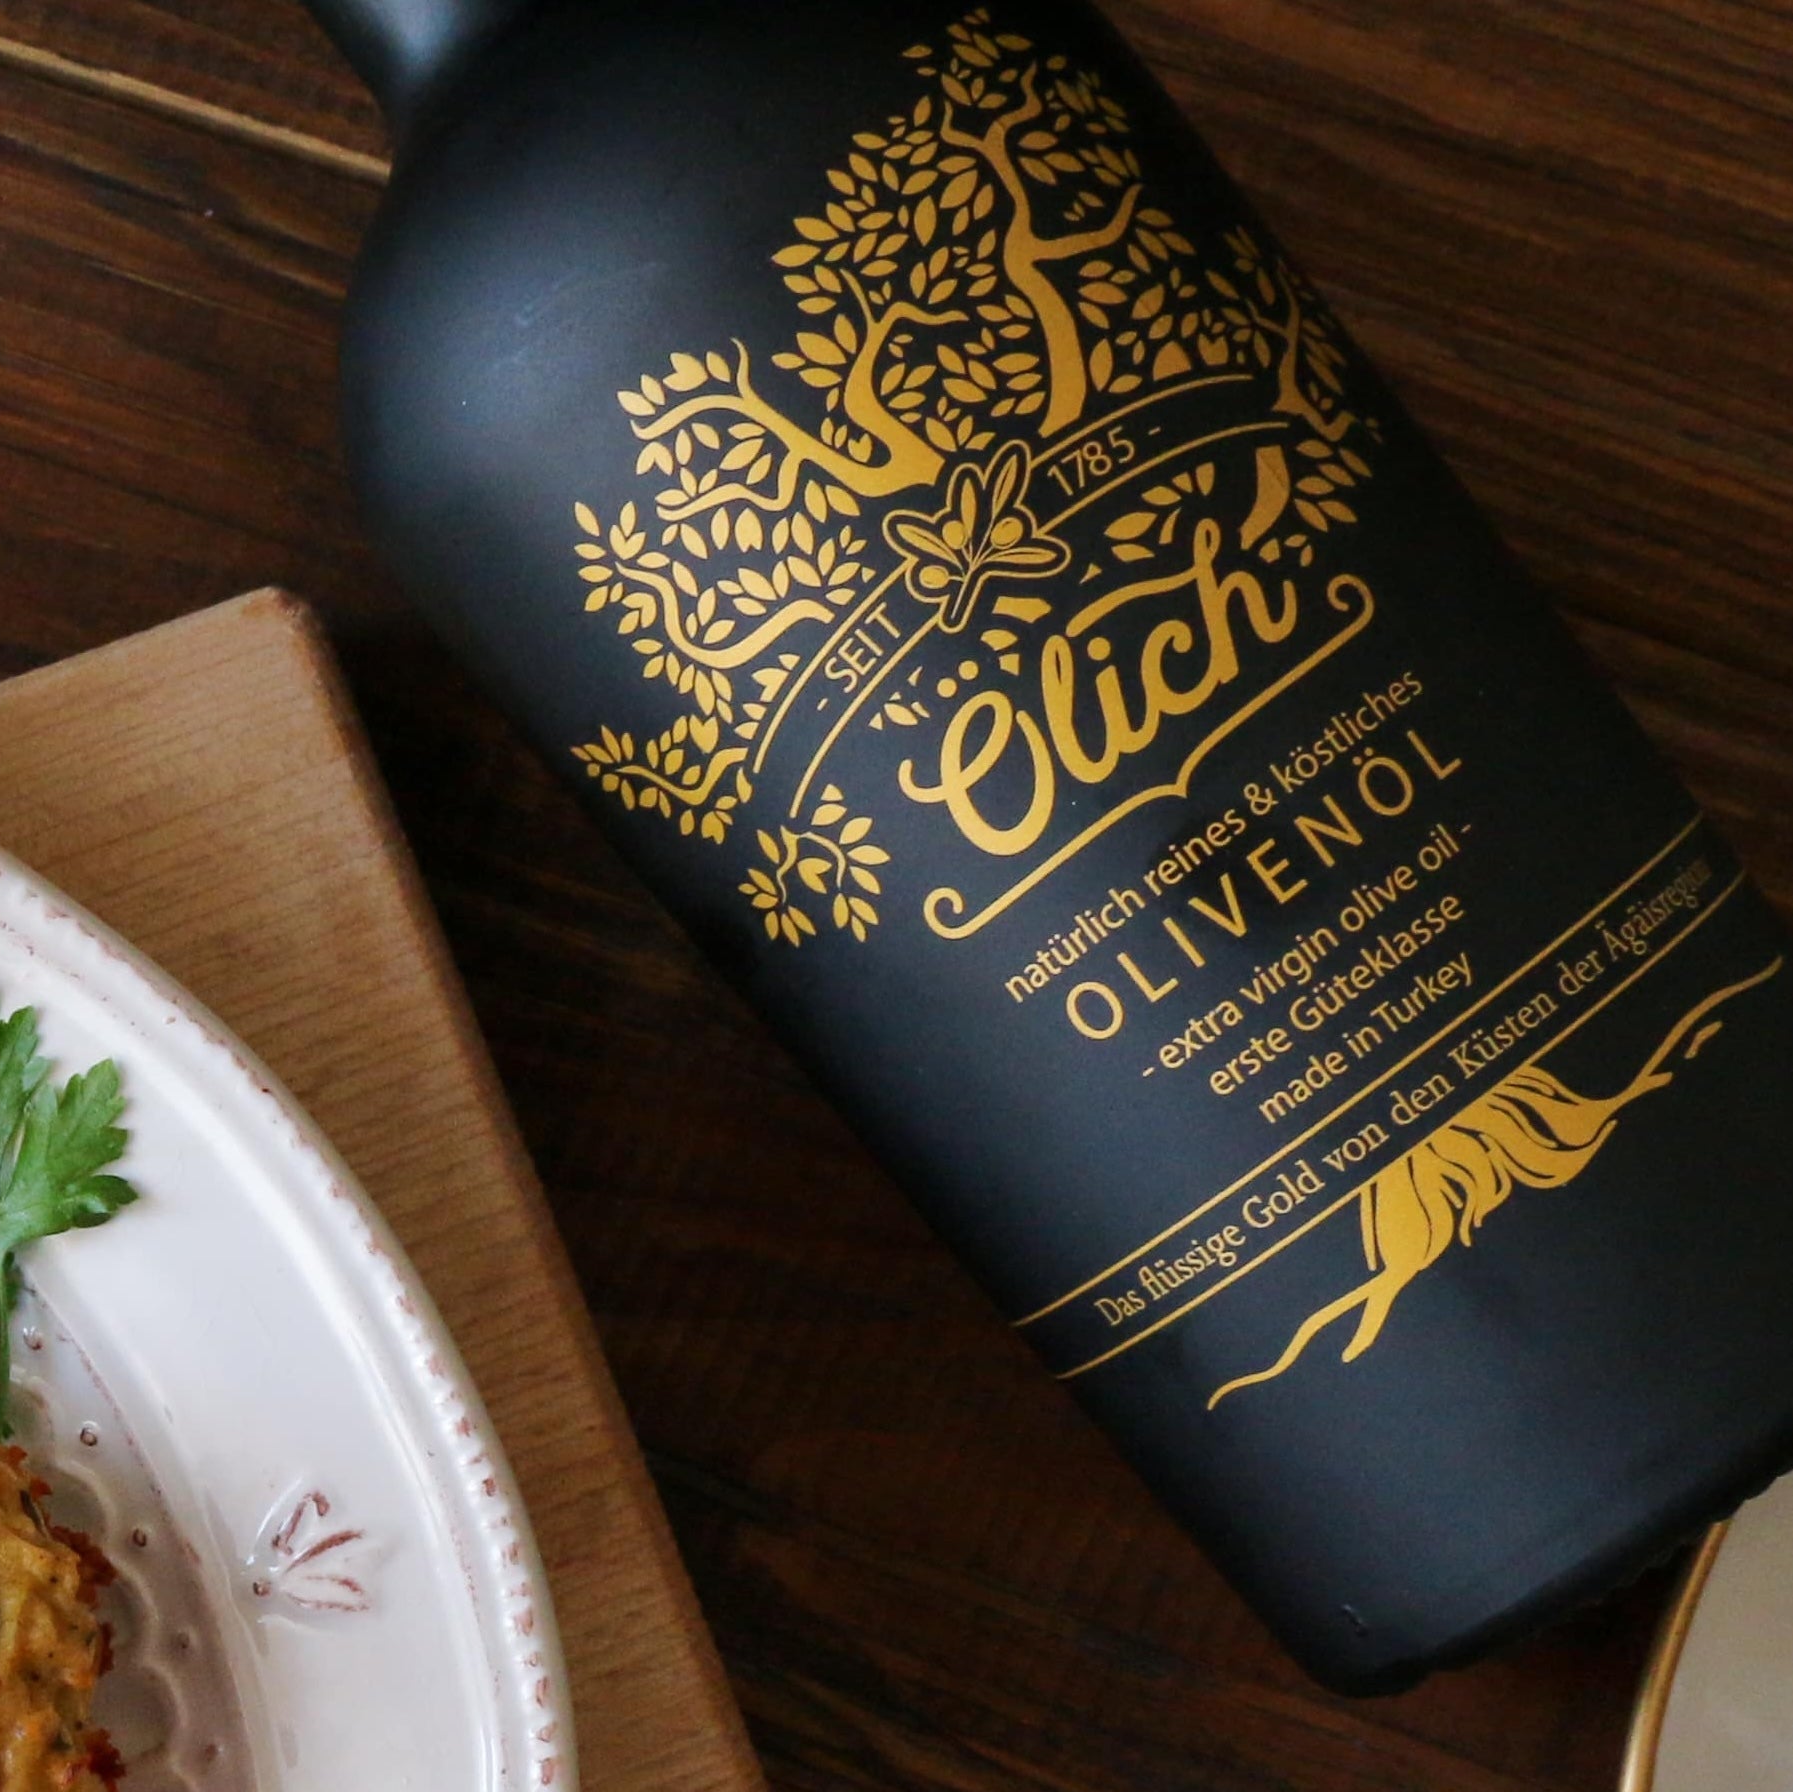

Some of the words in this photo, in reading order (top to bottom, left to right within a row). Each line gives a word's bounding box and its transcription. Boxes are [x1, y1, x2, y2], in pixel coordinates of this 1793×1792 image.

[823, 602, 903, 693] SEIT
[1047, 427, 1136, 498] 1785
[1004, 887, 1147, 1003] natürlich
[1143, 807, 1247, 897] reines
[1242, 782, 1278, 817] &
[1269, 671, 1423, 793] köstliches
[1065, 729, 1463, 1041] OLIVENÖL
[1158, 999, 1244, 1069] extra
[1239, 934, 1340, 1005] virgin
[1339, 864, 1418, 933] olive
[1418, 823, 1461, 871] oil
[1209, 1027, 1293, 1096] erste
[1288, 895, 1466, 1033] Güteklasse
[1259, 1054, 1349, 1124] made
[1341, 1026, 1383, 1058] in
[1369, 952, 1473, 1032] Turkey
[1094, 1289, 1146, 1325] Das
[1138, 1224, 1246, 1300] flüssige
[1242, 1159, 1325, 1229] Gold
[1322, 1121, 1390, 1172] von
[1391, 1073, 1455, 1126] den
[1447, 992, 1559, 1080] Küsten
[1557, 950, 1605, 996] der
